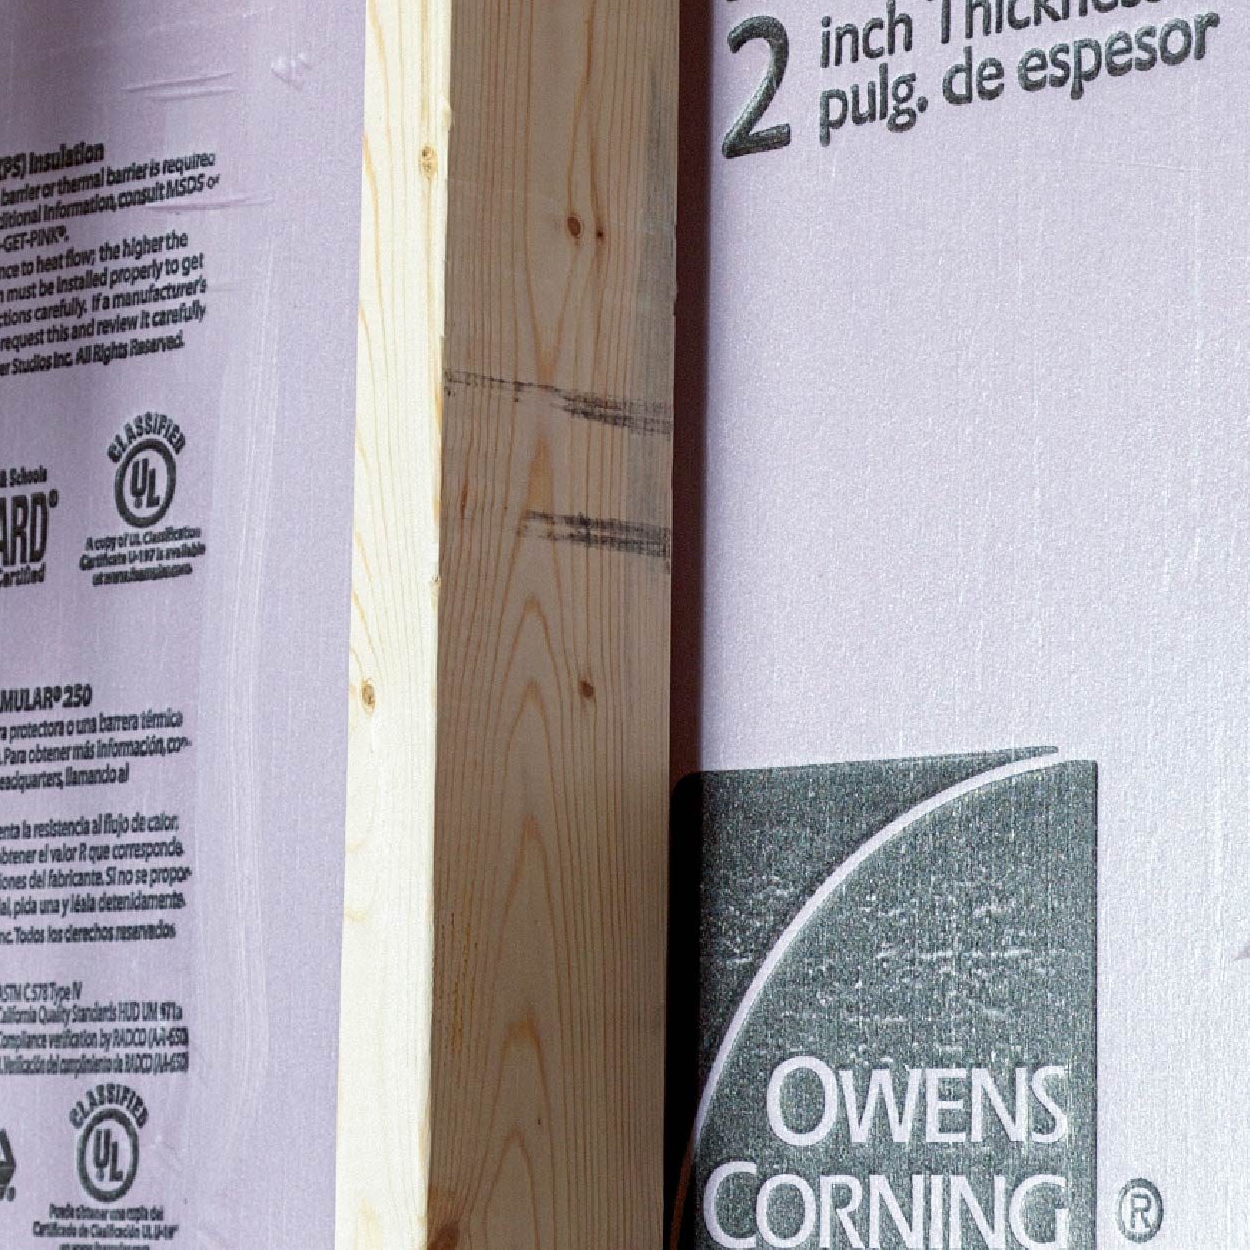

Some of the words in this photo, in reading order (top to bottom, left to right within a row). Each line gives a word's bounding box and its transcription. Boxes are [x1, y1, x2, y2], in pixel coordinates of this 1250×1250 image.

[722, 15, 791, 159] 2
[820, 64, 929, 146] pulg.
[942, 46, 1005, 105] de
[1017, 11, 1221, 100] espesor
[29, 142, 104, 174] Insulation
[56, 168, 103, 195] thermal
[106, 163, 148, 187] barrier
[162, 152, 217, 177] required
[118, 182, 166, 209] consult
[36, 252, 65, 273] heat
[99, 242, 121, 263] the
[122, 234, 164, 261] higher
[165, 230, 189, 252] the
[39, 279, 55, 298] be
[57, 266, 108, 294] installed
[110, 259, 163, 290] properly
[165, 256, 180, 276] to
[182, 252, 204, 277] get
[96, 314, 138, 336] review
[107, 411, 186, 463] CLASSIFIED
[62, 683, 93, 708] 250
[69, 1081, 148, 1129] CLASSIFIED
[766, 1055, 1068, 1146] OWENS
[702, 1159, 1069, 1250] CORNING
